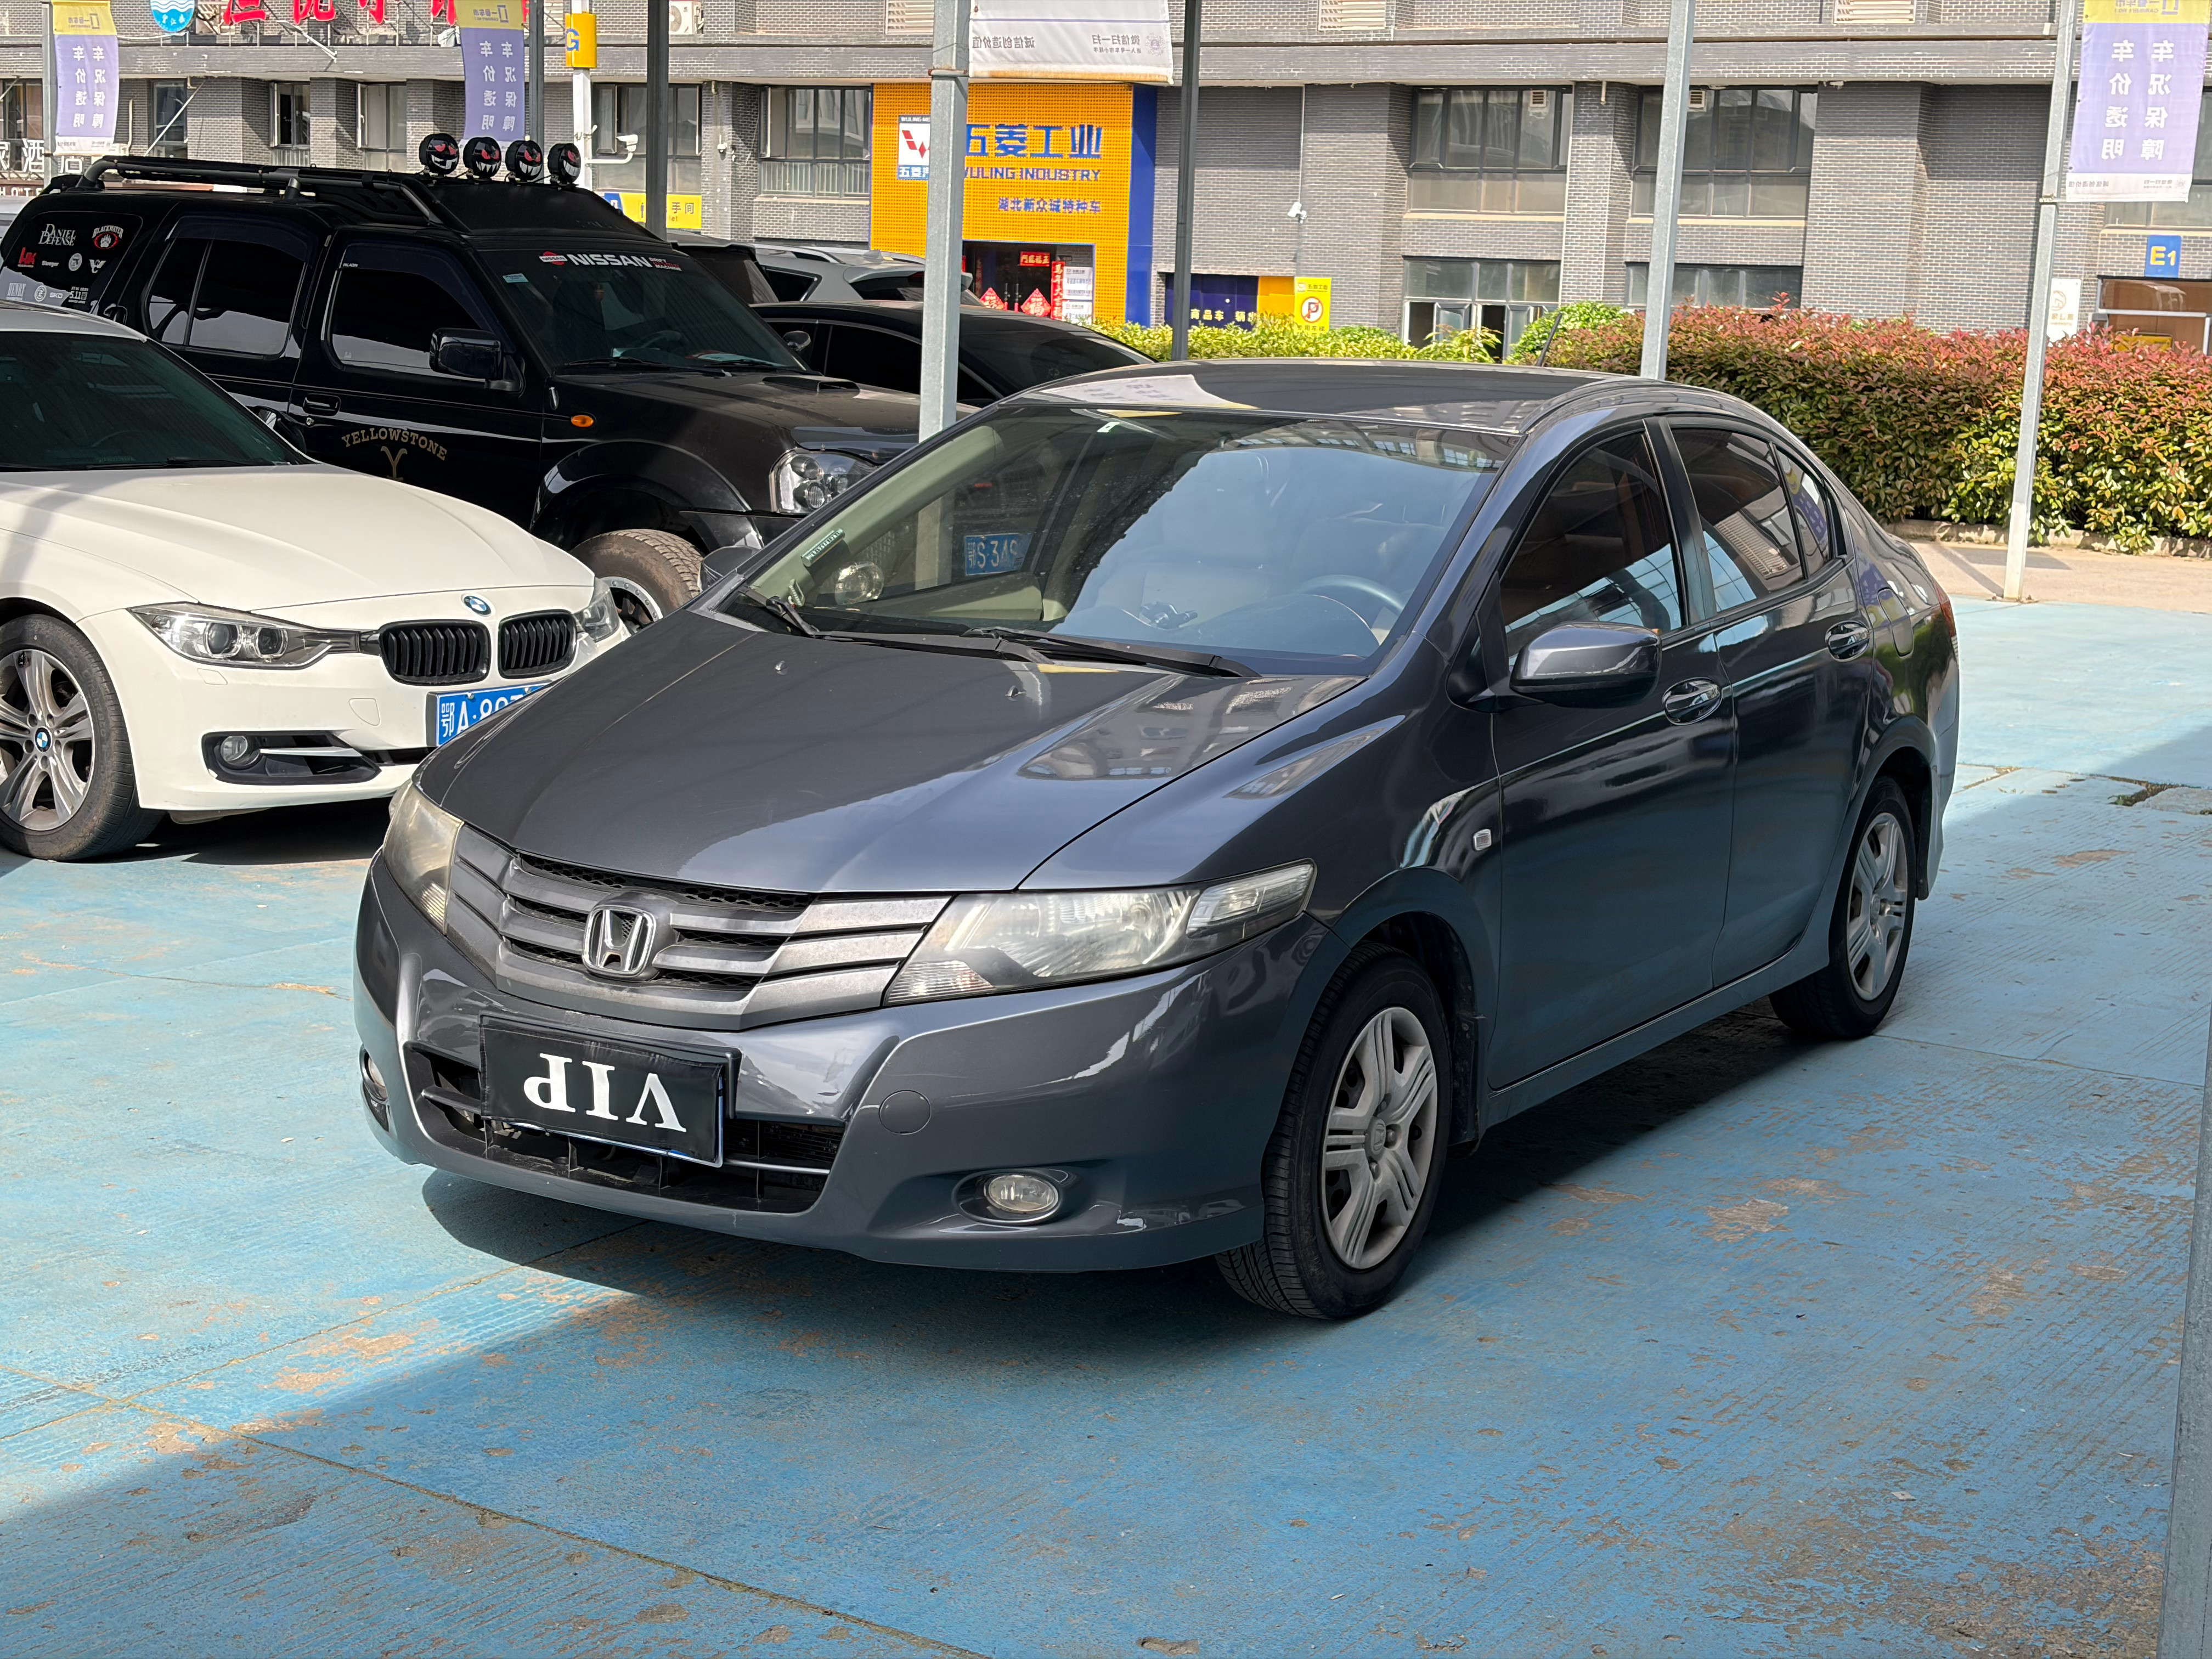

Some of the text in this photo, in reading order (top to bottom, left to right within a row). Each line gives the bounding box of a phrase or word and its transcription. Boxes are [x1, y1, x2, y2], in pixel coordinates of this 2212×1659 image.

[966, 124, 1102, 159] 五菱工业
[964, 167, 1101, 182] ULING INDUSTRY
[672, 201, 695, 215] 手间
[38, 230, 76, 246] DEFENSE
[44, 223, 76, 239] DANIEL
[92, 225, 124, 239] BLACKWATER
[567, 254, 653, 268] NISSAN
[2149, 246, 2177, 266] E1
[342, 427, 448, 461] YELLOWSTONE
[523, 1053, 686, 1132] VIP
